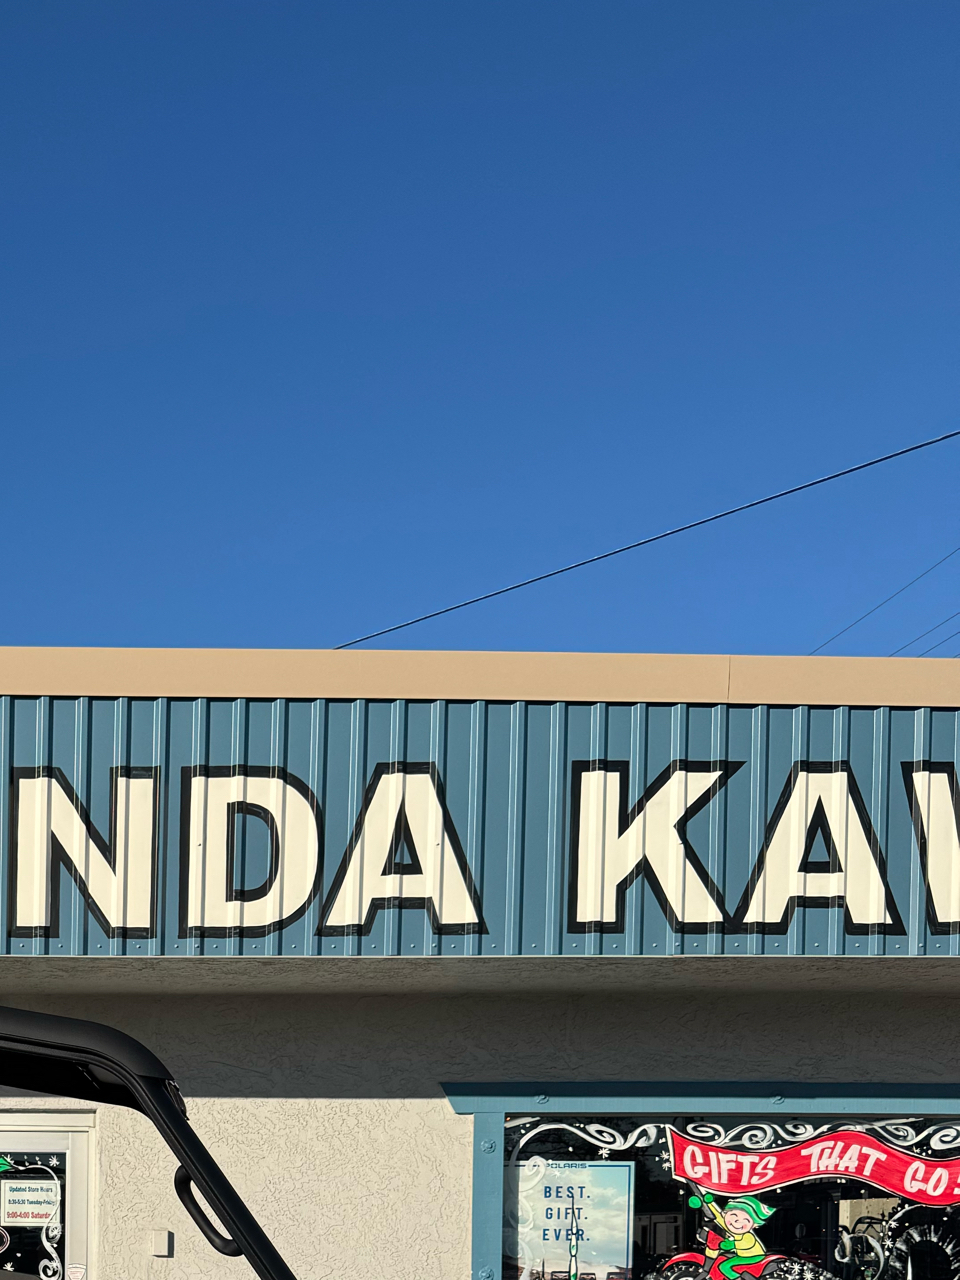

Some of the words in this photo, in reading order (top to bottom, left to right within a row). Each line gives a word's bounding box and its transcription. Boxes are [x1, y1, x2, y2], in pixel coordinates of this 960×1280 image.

[683, 1145, 777, 1185] GIFTS
[801, 1141, 887, 1177] THAT
[543, 1186, 591, 1198] BEST.
[31, 1211, 52, 1219] Saturda
[545, 1207, 588, 1220] GIFT.
[542, 1228, 590, 1241] EVER.
